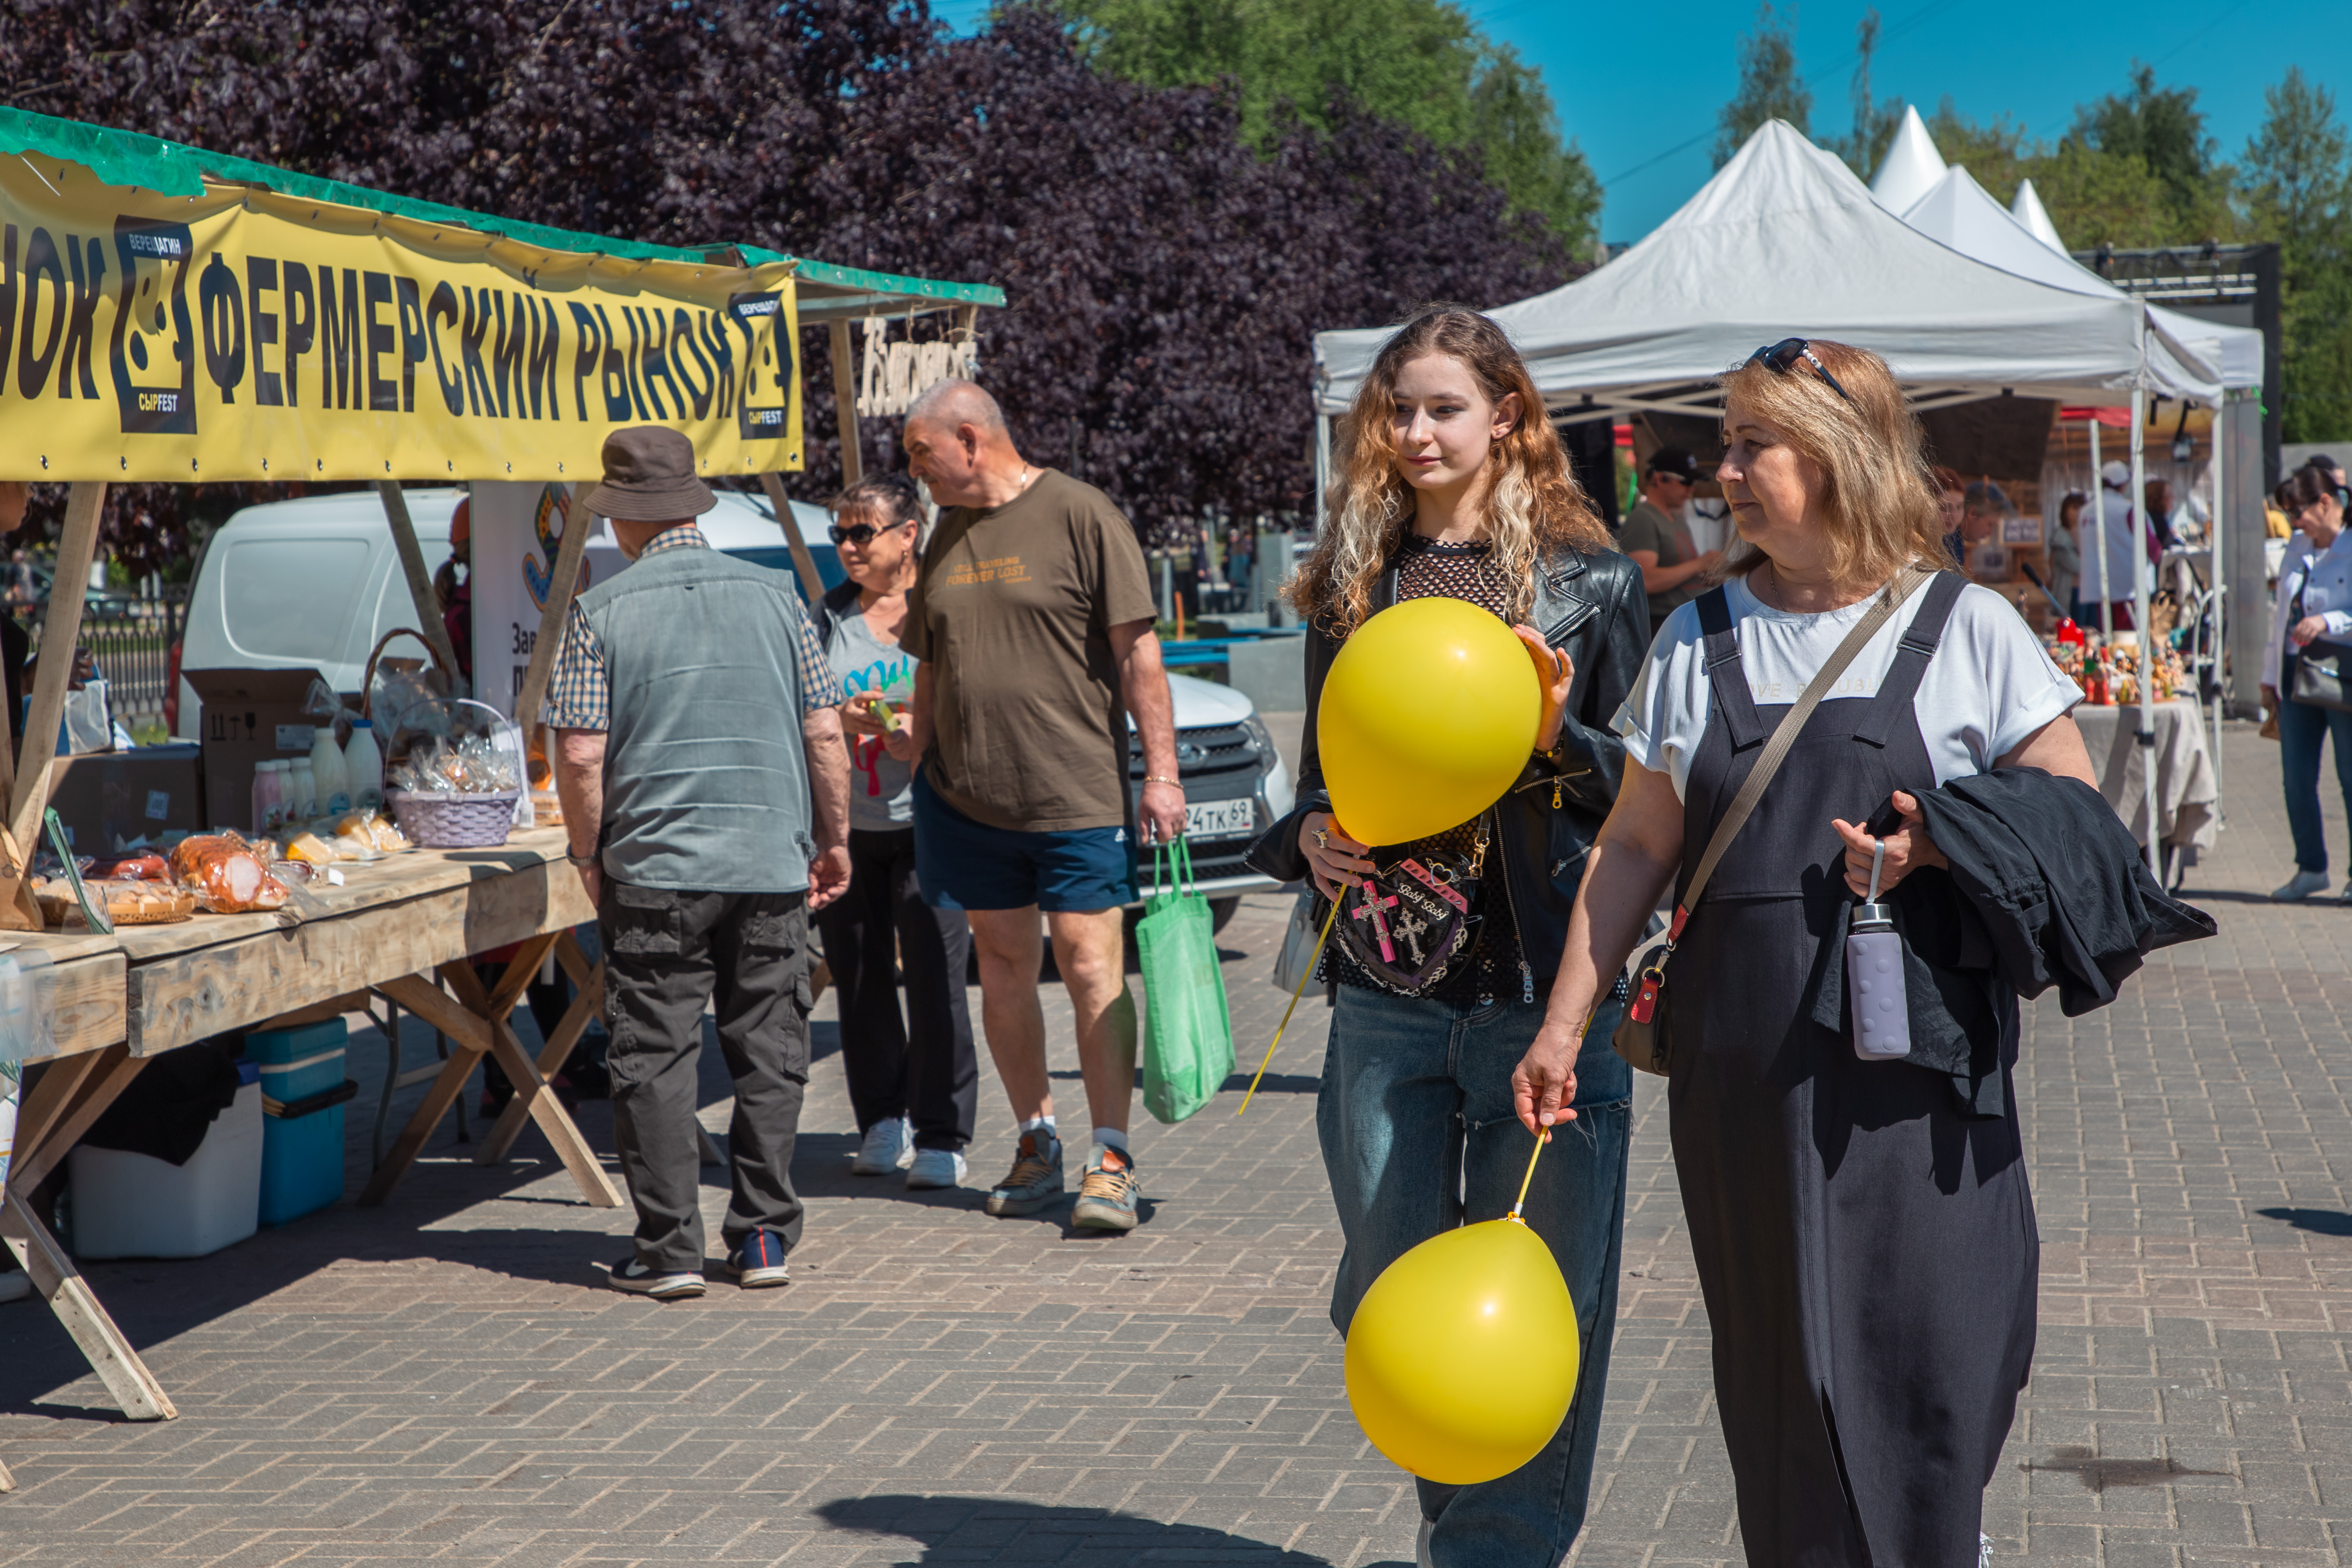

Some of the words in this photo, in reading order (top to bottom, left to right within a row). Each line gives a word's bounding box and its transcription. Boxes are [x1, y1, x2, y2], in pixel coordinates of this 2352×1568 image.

[129, 234, 182, 256] ВЕРЕЩАГИН
[199, 252, 560, 421] ФЕРМЕРСКИЙ
[566, 300, 735, 422] РЫНОК
[139, 393, 178, 412] СЫРFEST
[975, 556, 1020, 569] TRAVELING
[945, 570, 994, 587] FOREVER
[997, 565, 1026, 579] LOST
[1231, 801, 1247, 820] 69
[1398, 883, 1425, 903] Baby
[1421, 899, 1449, 921] Baby
